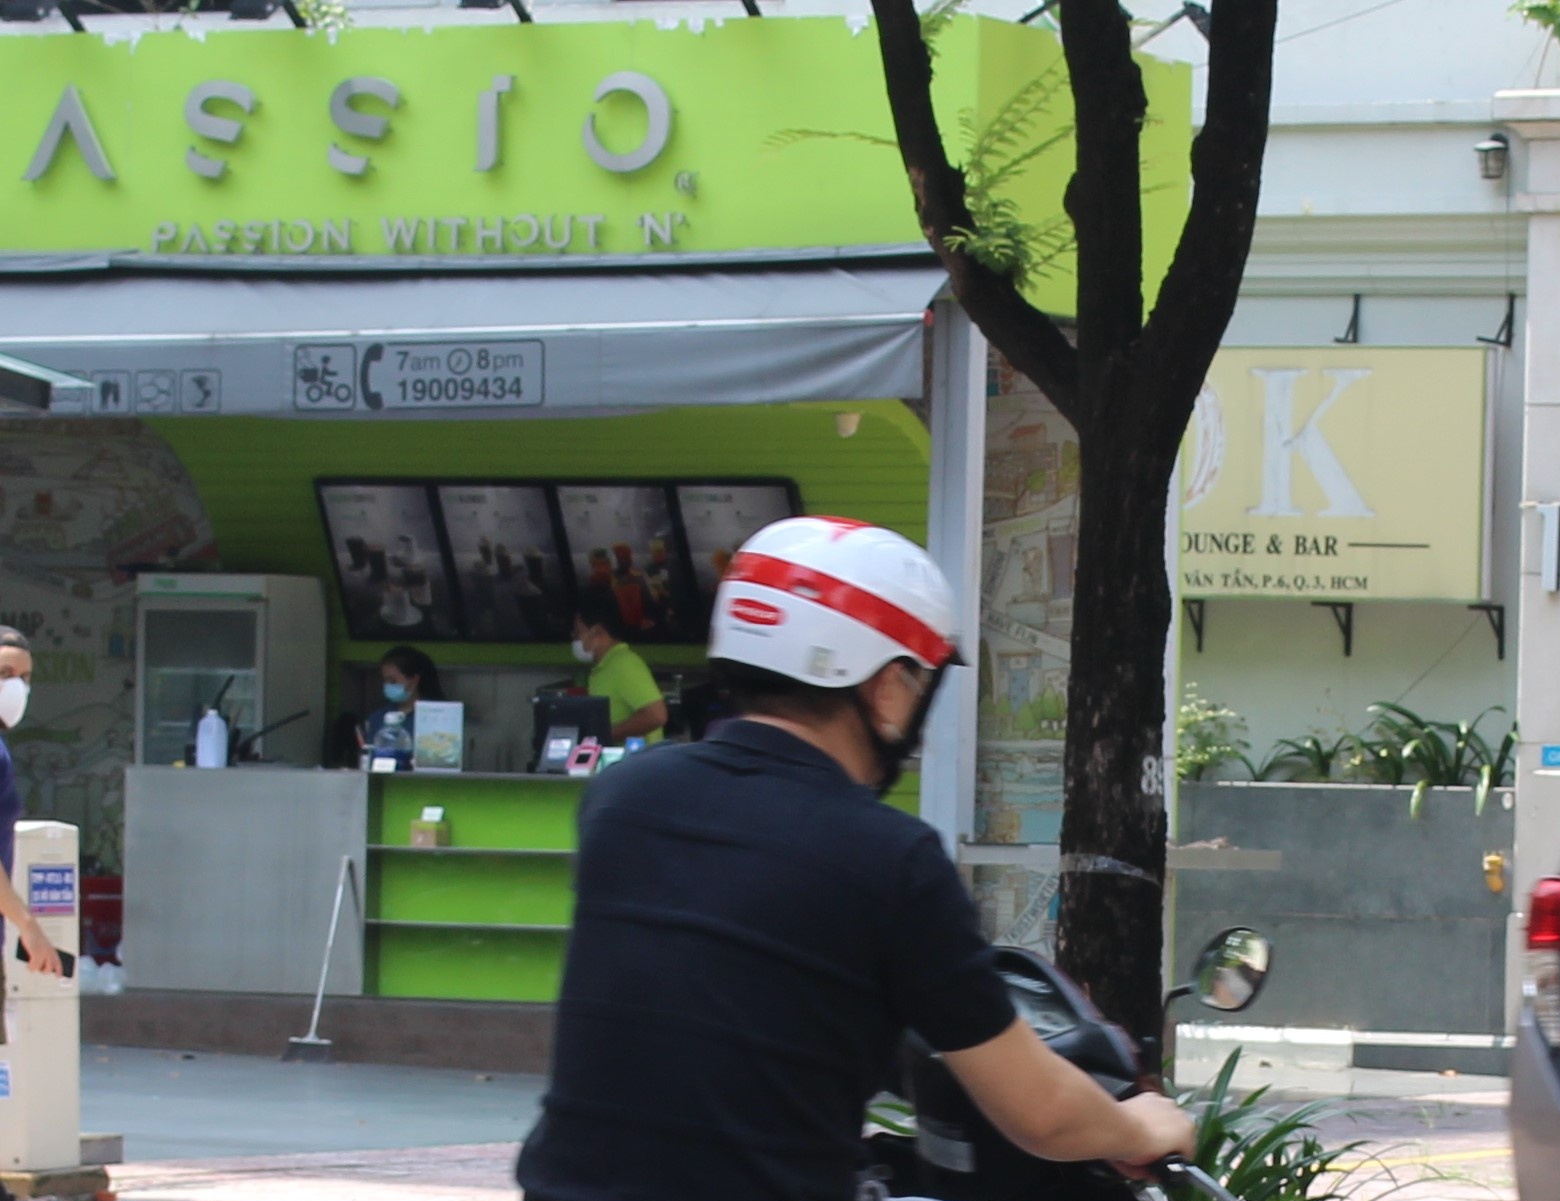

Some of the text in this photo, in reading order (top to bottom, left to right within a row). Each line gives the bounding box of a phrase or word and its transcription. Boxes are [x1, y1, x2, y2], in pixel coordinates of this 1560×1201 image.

[153, 218, 352, 254] PASSION
[380, 213, 604, 250] WITHOUT
[396, 348, 524, 373] 7am 8pm
[397, 375, 523, 401] 19009434
[1266, 534, 1283, 555] &
[1294, 535, 1338, 556] BAR
[1330, 576, 1368, 590] HCM
